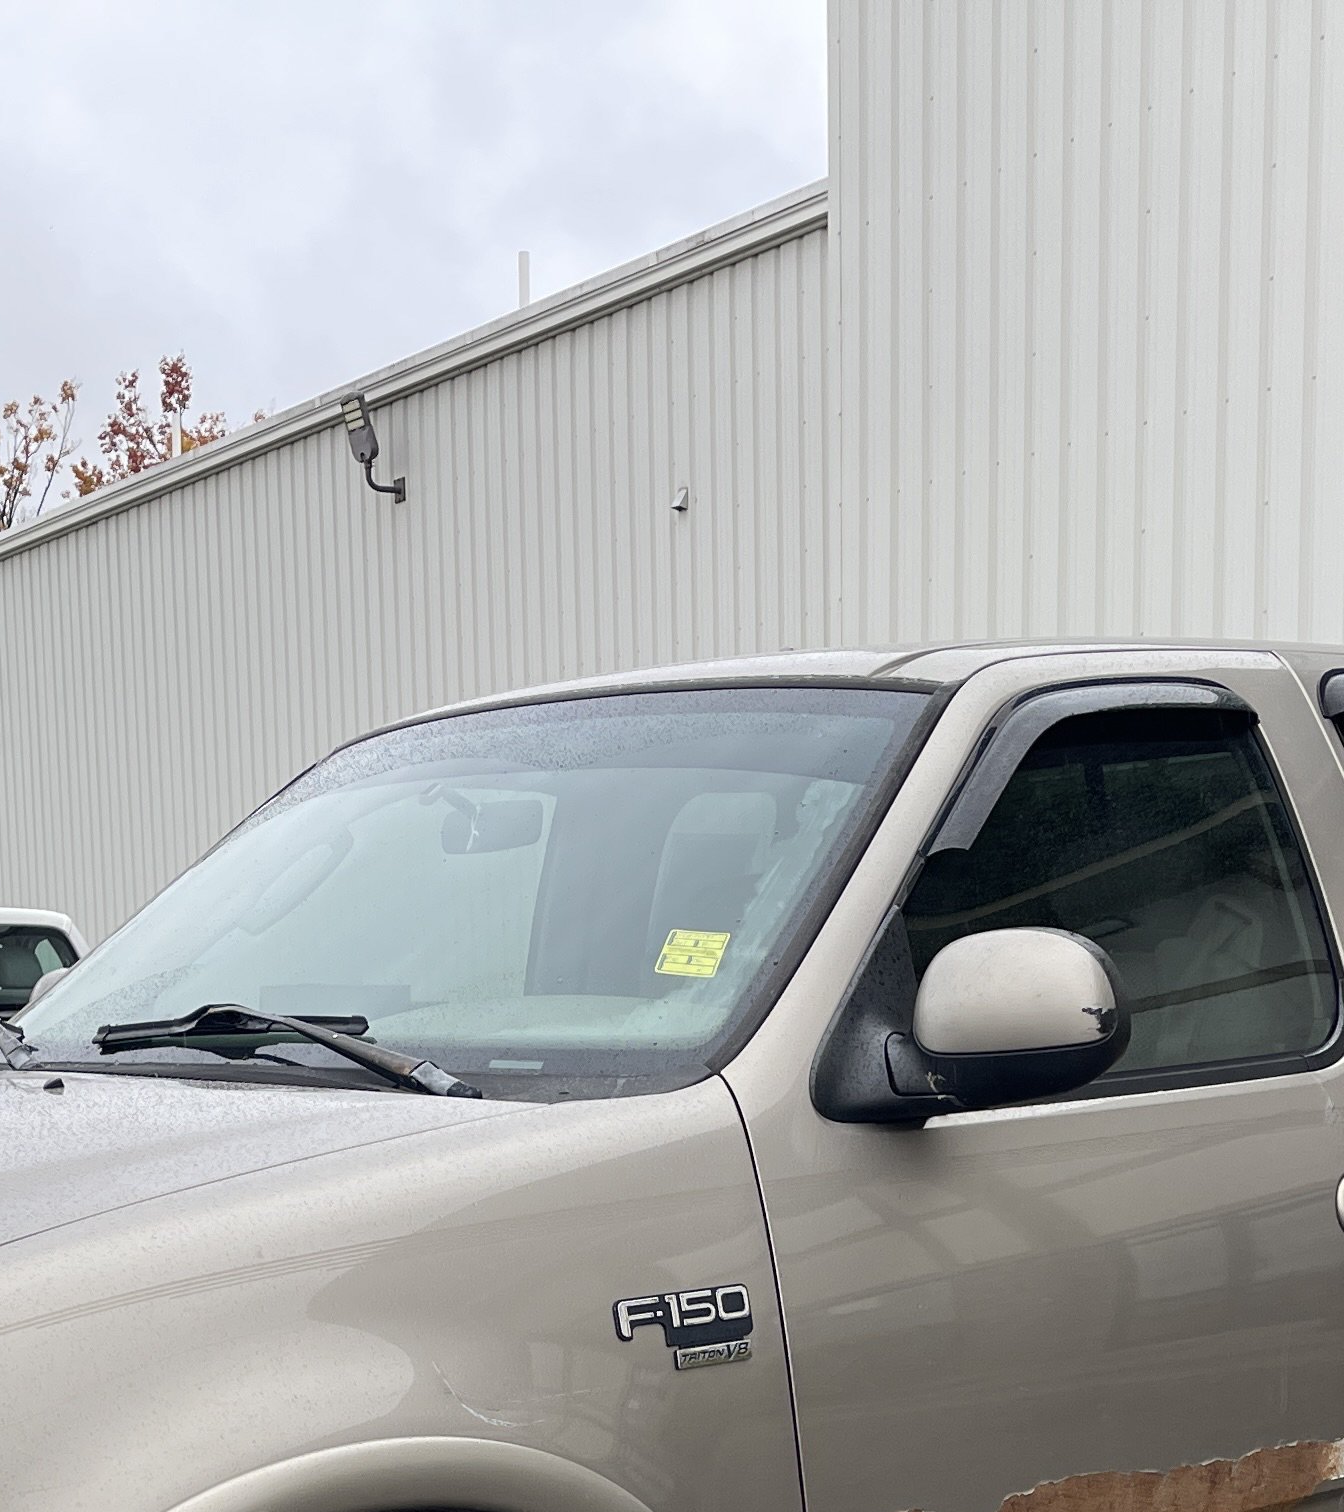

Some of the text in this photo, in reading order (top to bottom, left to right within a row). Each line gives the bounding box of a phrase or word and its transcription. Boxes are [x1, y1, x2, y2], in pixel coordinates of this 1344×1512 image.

[617, 1285, 750, 1338] F-150
[680, 1341, 749, 1365] TRITON V8
